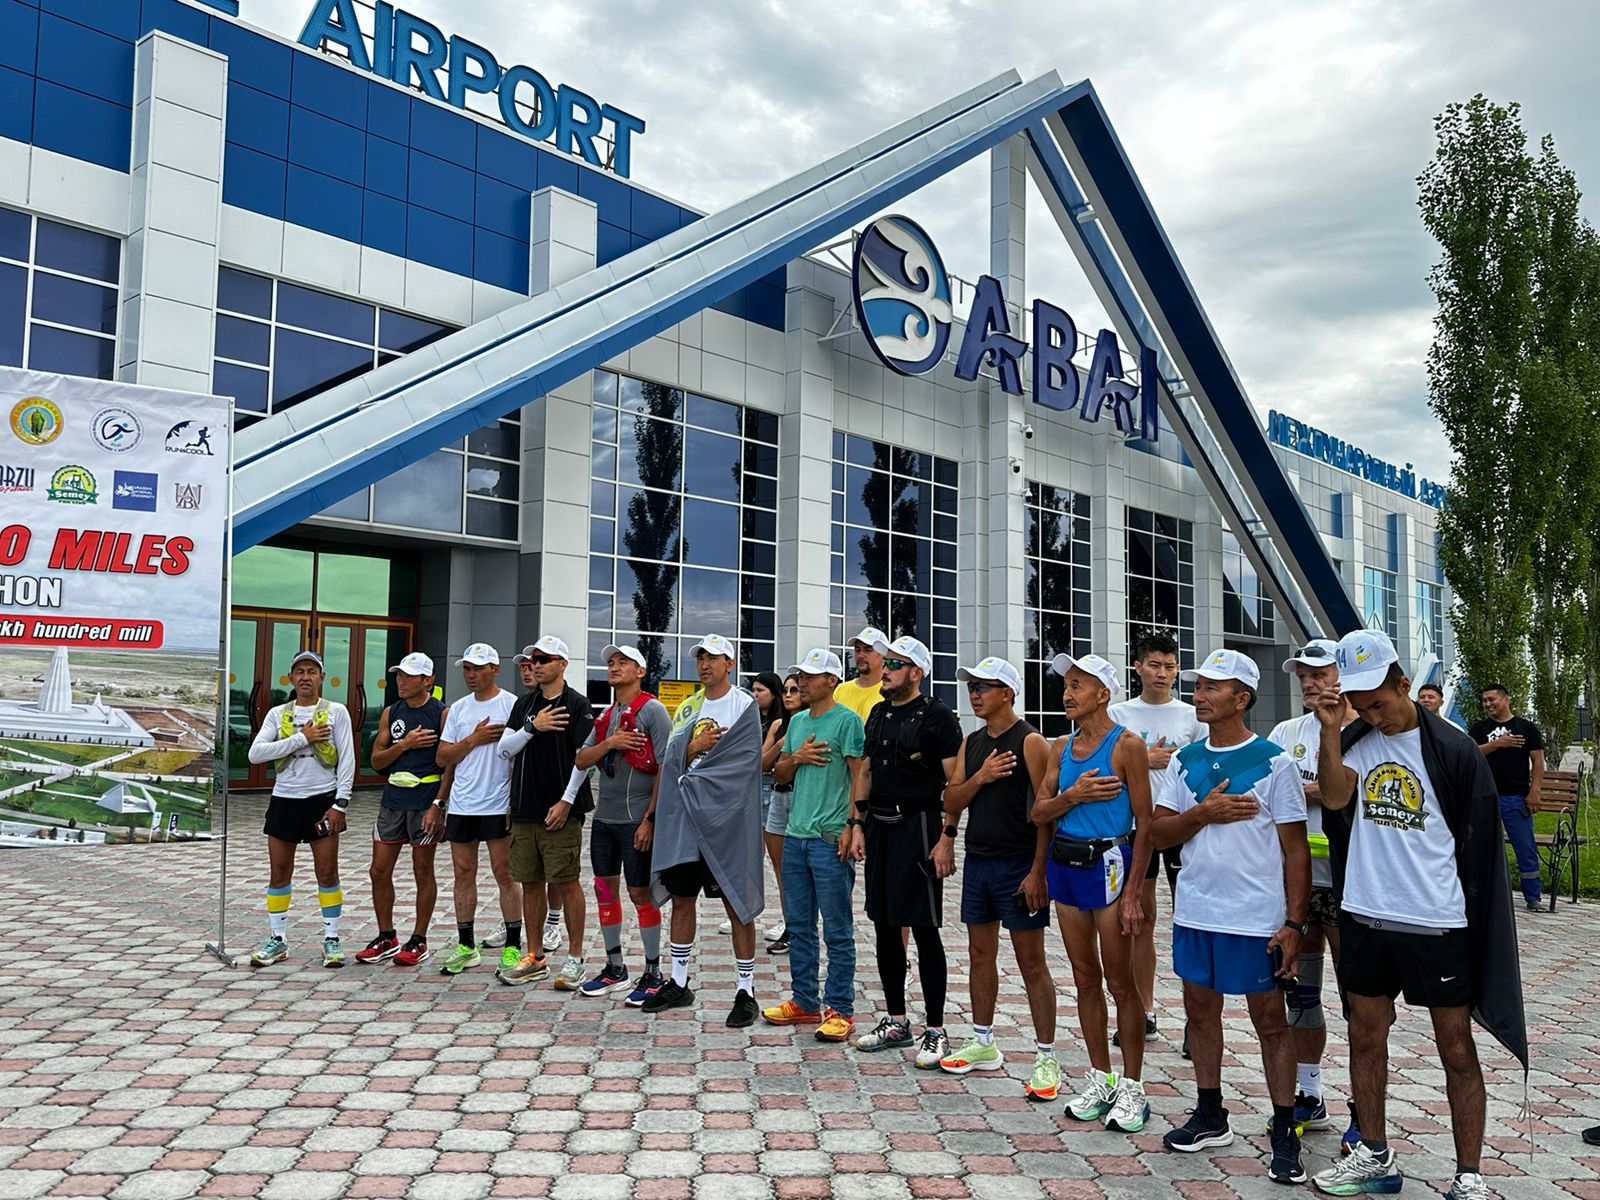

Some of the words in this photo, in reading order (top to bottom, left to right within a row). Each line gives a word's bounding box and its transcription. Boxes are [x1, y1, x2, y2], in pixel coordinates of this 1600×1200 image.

[297, 0, 646, 179] AIRPORT
[954, 274, 1158, 442] ABAI
[55, 491, 90, 501] Semey
[48, 528, 194, 575] MILES
[32, 621, 112, 640] hundred
[118, 625, 153, 642] mill
[1369, 804, 1415, 823] Semey
